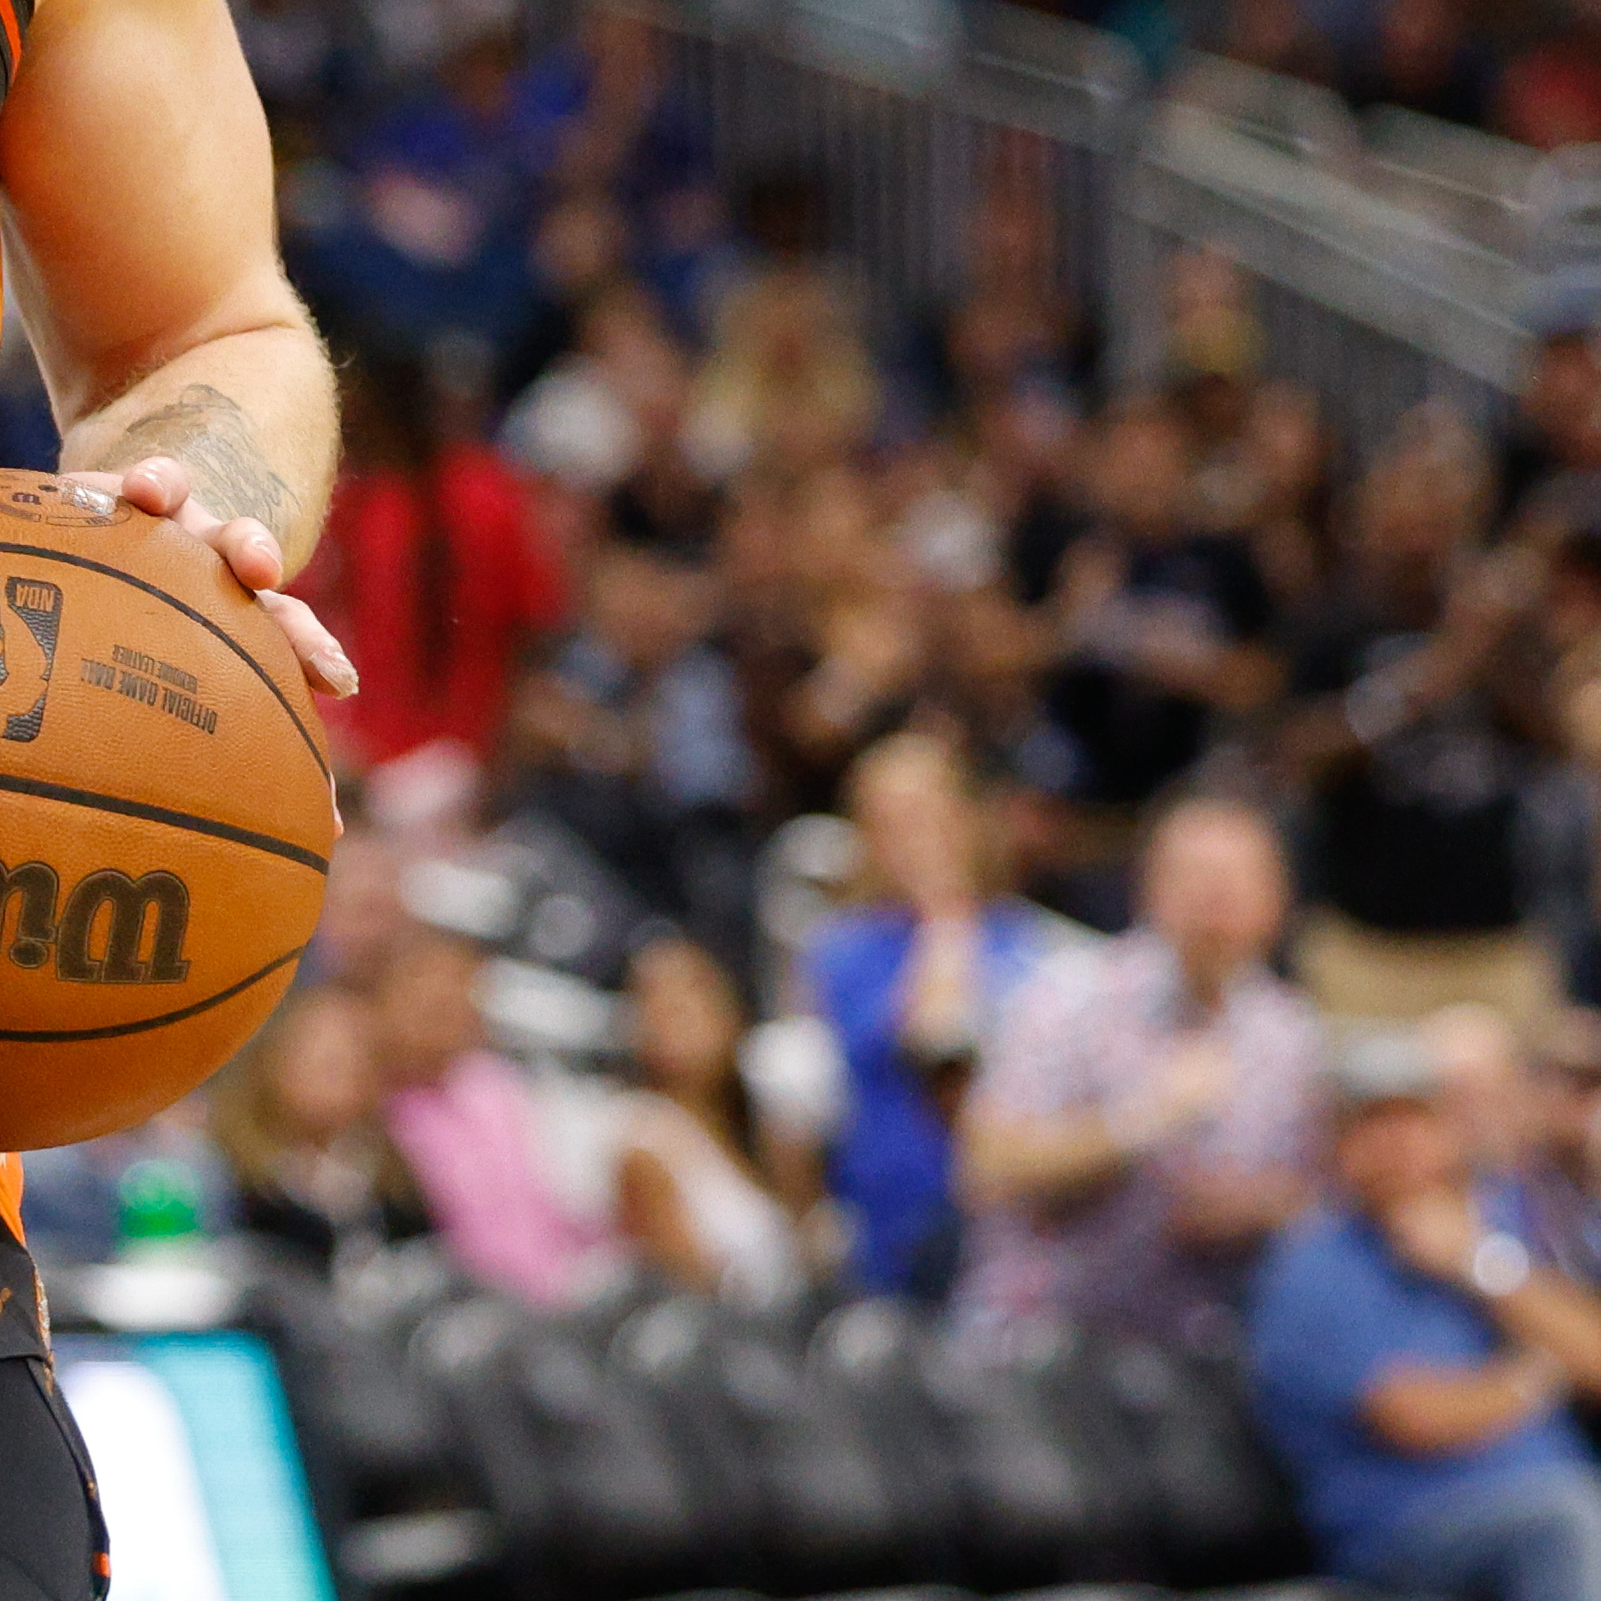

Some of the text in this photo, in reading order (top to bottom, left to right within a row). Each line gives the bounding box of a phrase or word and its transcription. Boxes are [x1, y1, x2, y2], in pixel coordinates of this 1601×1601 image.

[14, 583, 56, 612] NBA
[116, 668, 159, 707] GAME
[161, 686, 218, 736] OFFICIAL
